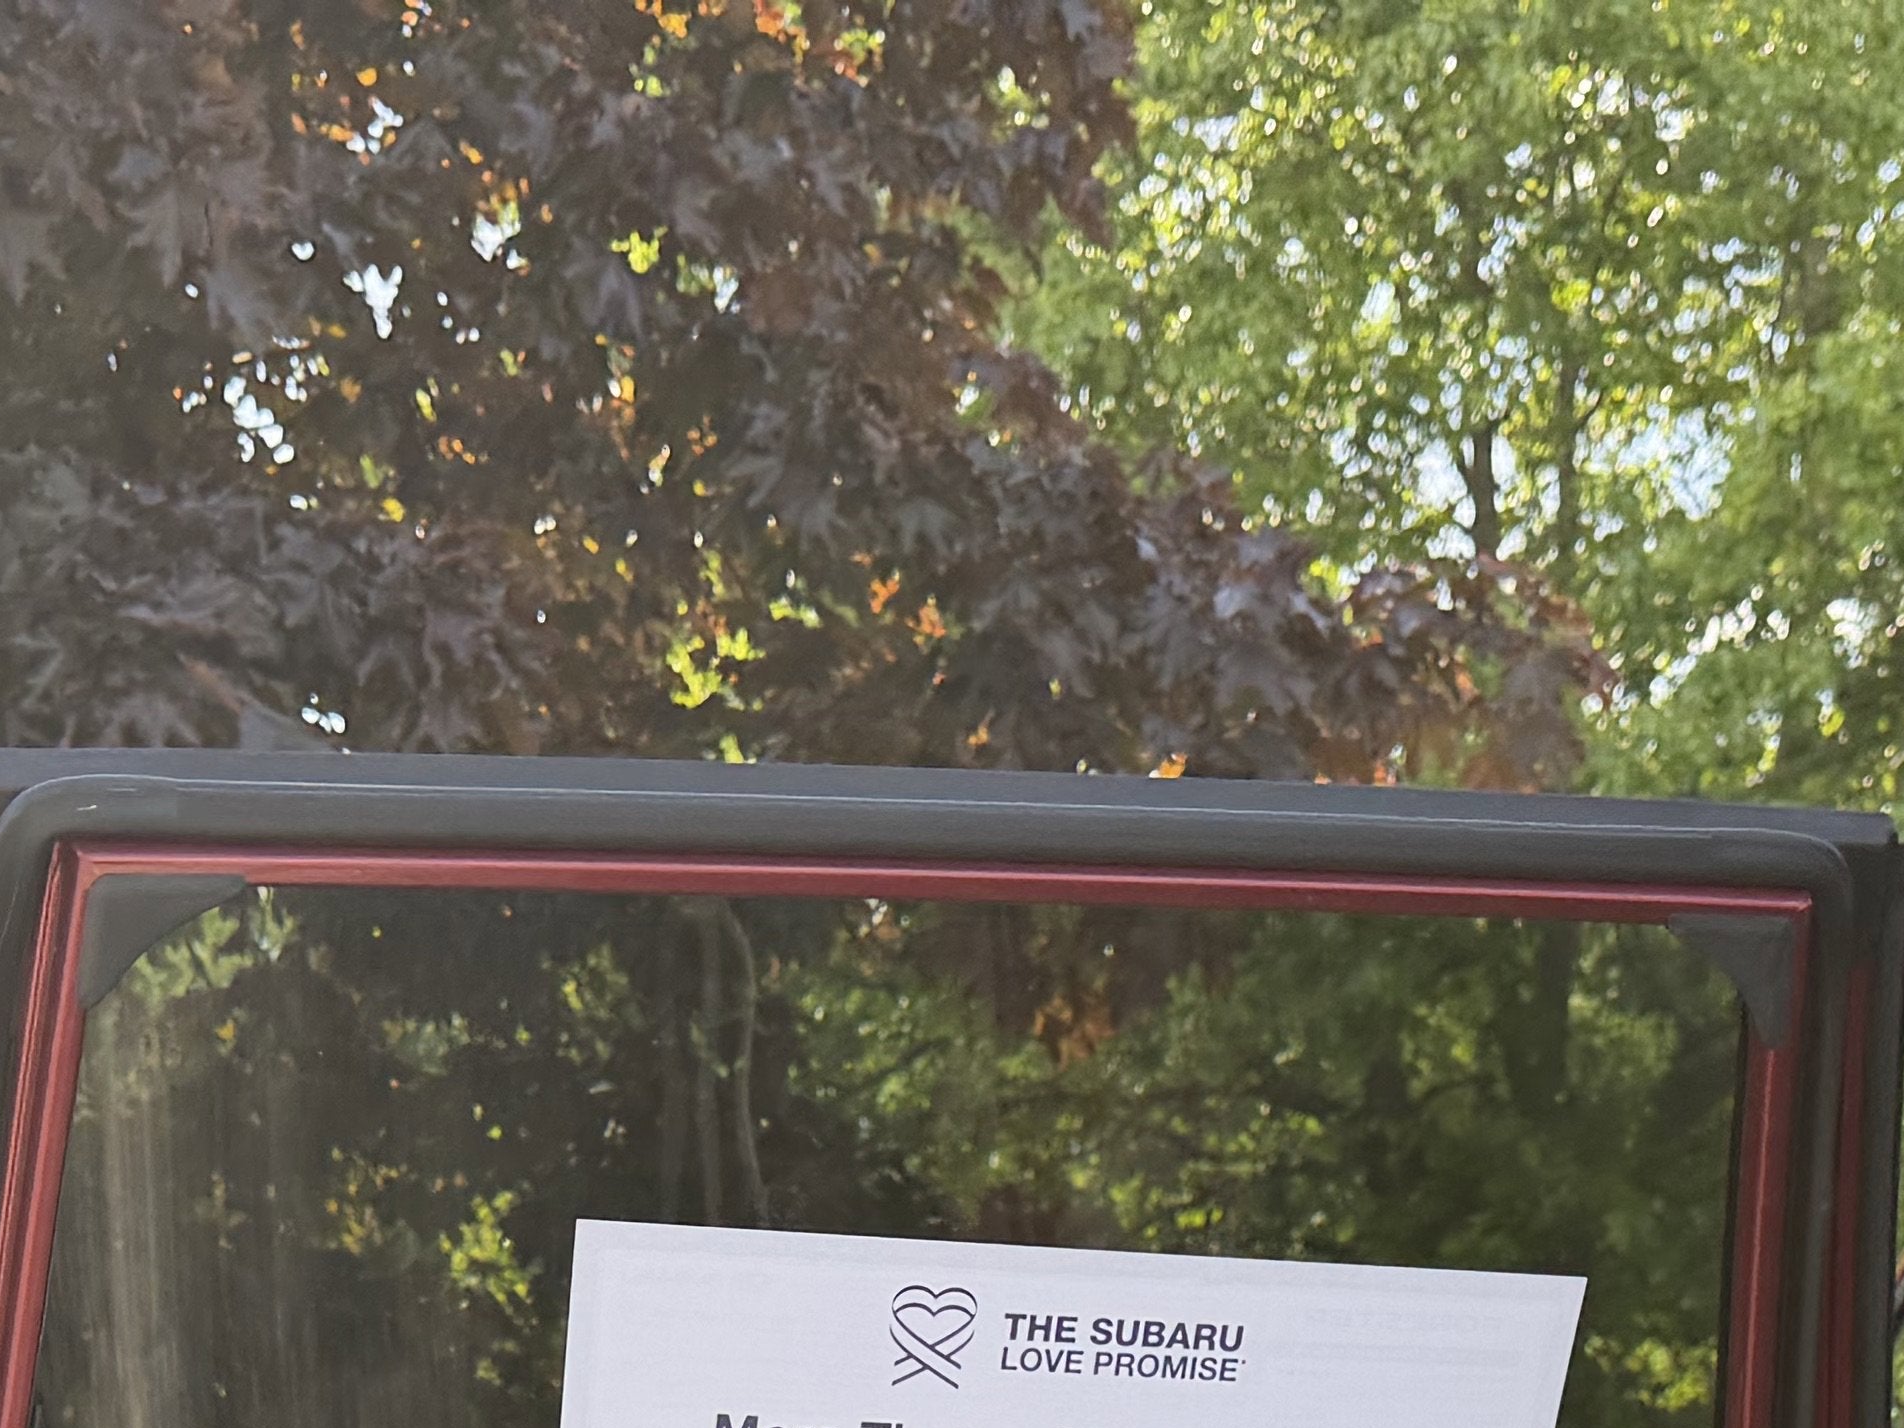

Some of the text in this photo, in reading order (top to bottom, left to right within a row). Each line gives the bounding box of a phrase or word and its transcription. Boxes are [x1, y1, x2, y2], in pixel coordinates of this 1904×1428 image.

[1005, 1313, 1244, 1352] THE SUBARU
[1002, 1347, 1238, 1381] LOVE PROMISE
